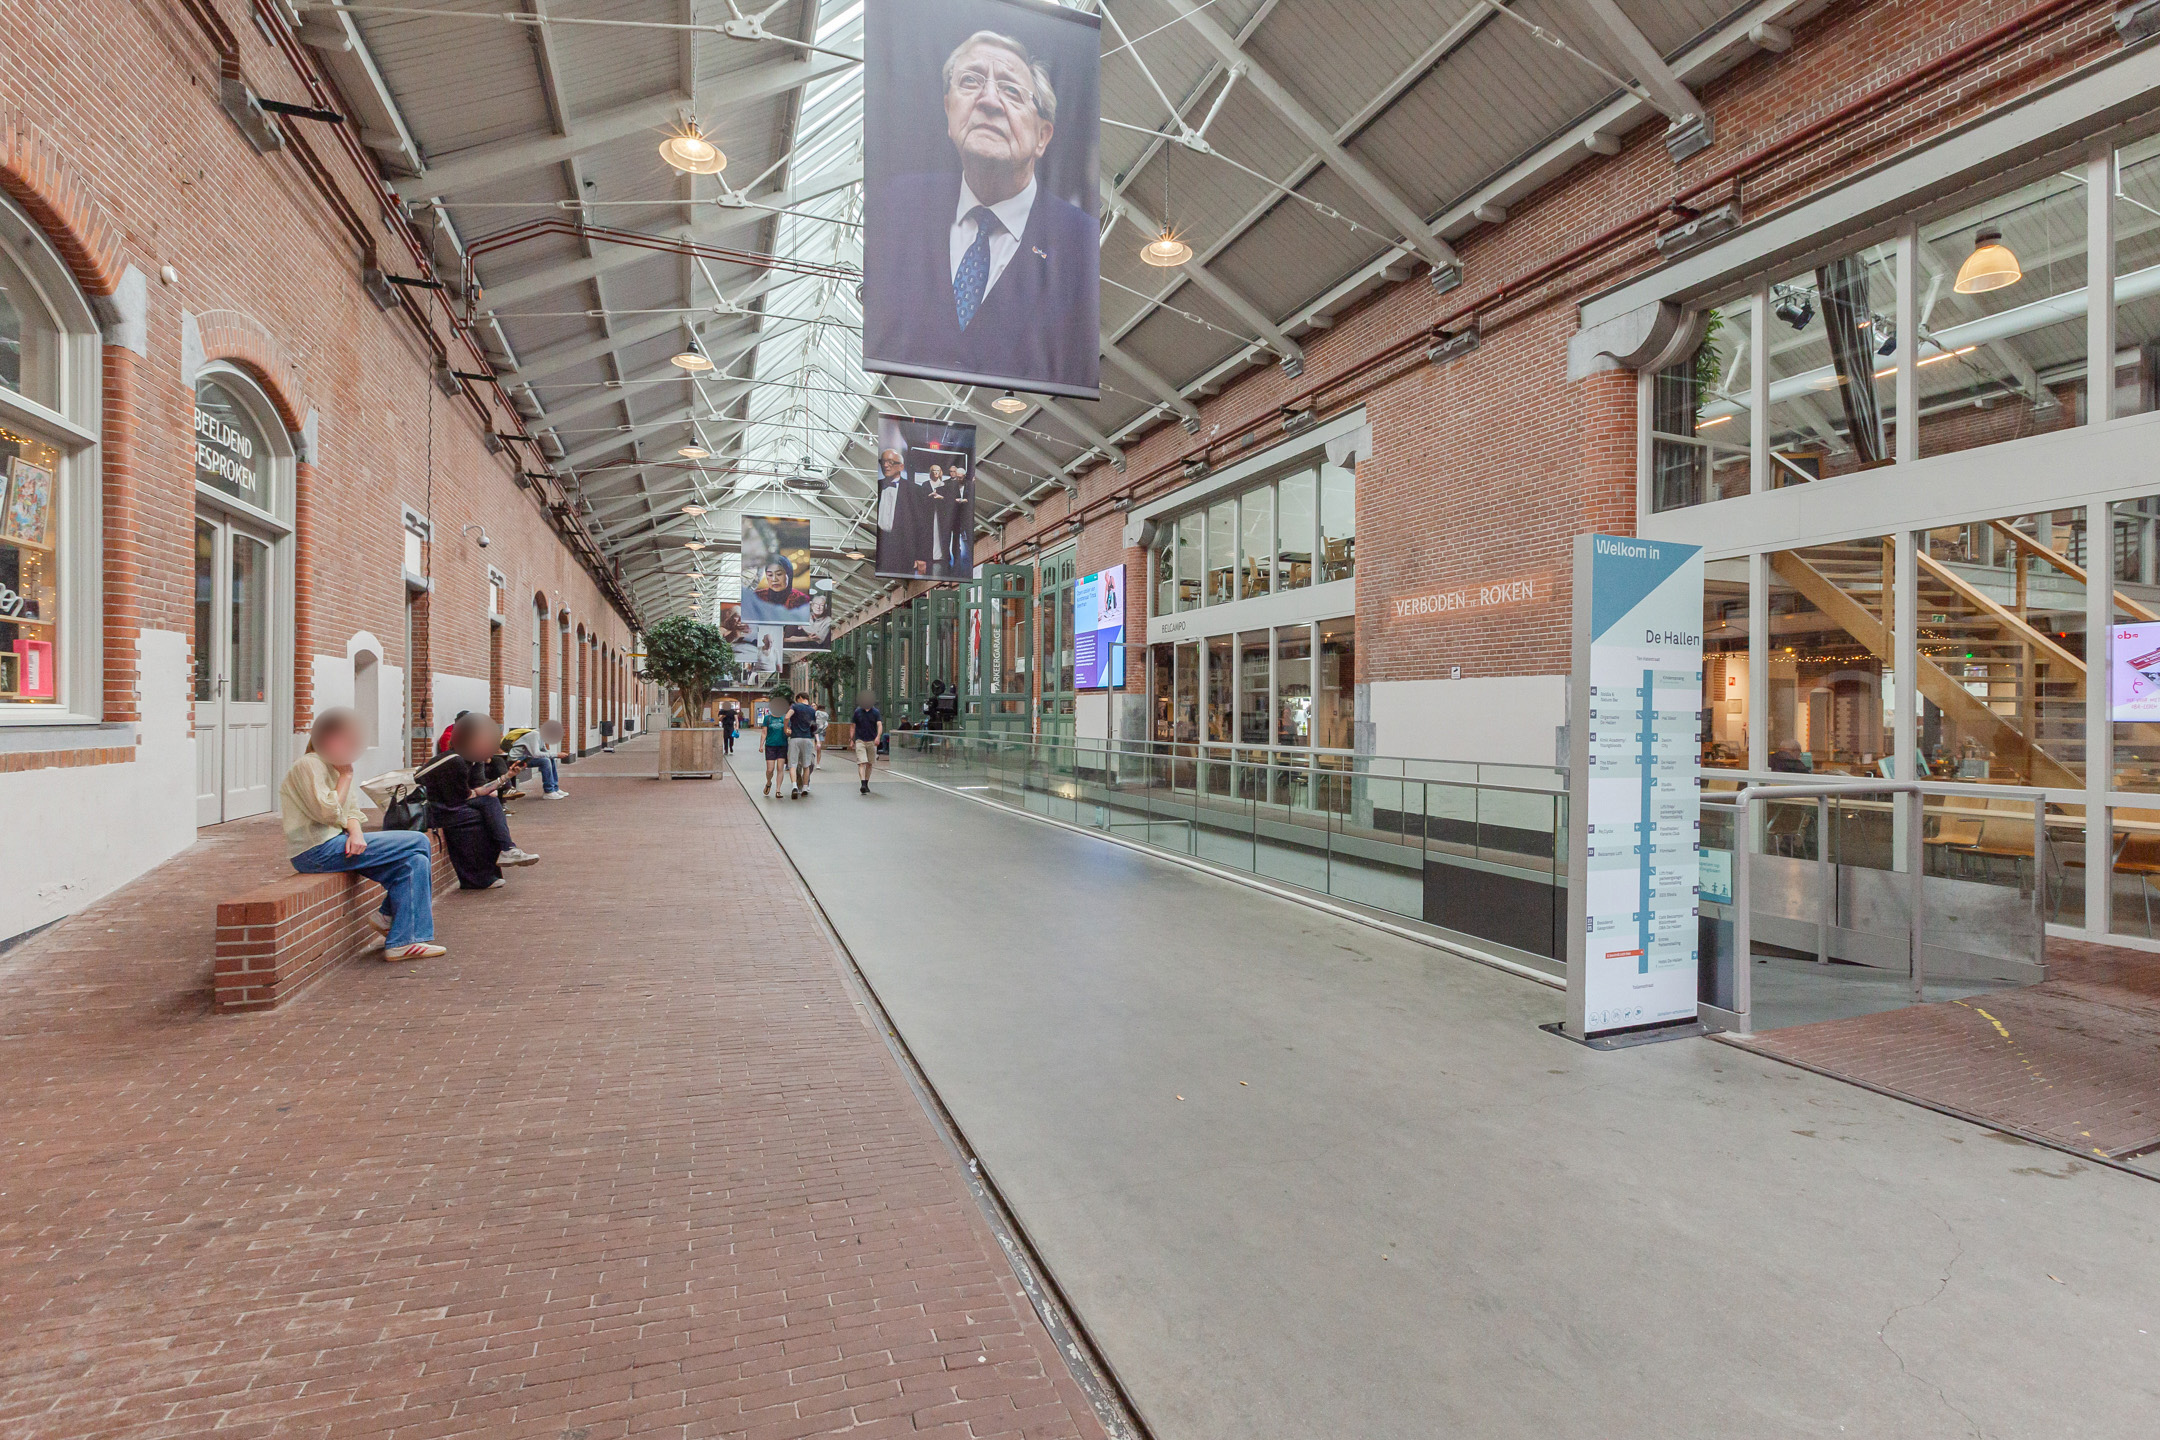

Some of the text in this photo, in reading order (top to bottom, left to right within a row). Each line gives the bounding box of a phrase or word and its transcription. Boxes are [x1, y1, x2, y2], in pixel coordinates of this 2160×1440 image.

[194, 406, 253, 459] BEELDEND
[1596, 539, 1660, 560] Welkom in
[1396, 591, 1466, 617] VERBODEN
[1480, 581, 1534, 606] ROKEN
[1162, 620, 1187, 634] BELCAMPO
[2117, 631, 2139, 639] oba
[1645, 629, 1700, 647] De Hallen
[993, 628, 1002, 692] PARKEERGARAGE
